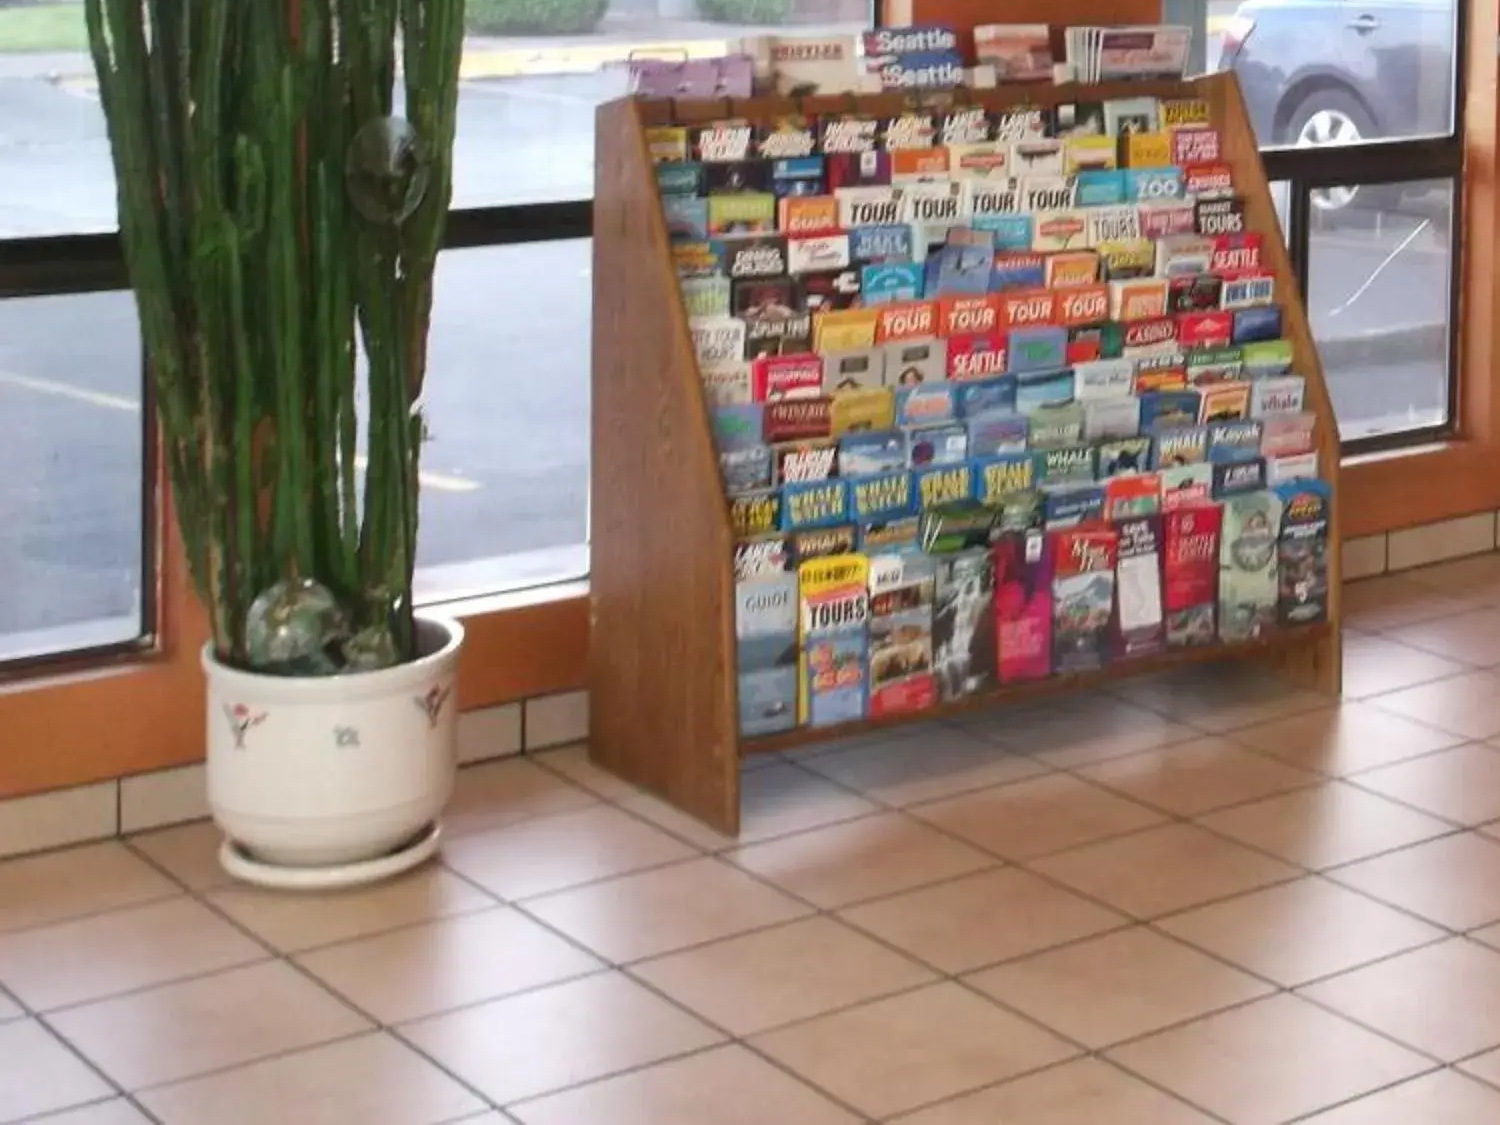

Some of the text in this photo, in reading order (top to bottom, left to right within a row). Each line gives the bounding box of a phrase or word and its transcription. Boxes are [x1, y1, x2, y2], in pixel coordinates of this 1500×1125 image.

[878, 27, 956, 52] Seattle
[889, 64, 963, 87] Seattle
[1138, 174, 1178, 198] ZOO
[911, 196, 958, 219] TOUR
[971, 192, 1016, 214] TOUR
[1027, 188, 1072, 210] TOUR
[850, 201, 898, 224] TOUR
[1200, 213, 1243, 234] TOURS
[1213, 248, 1259, 268] SEATTLE
[1007, 298, 1052, 323] TOUR
[1063, 294, 1107, 318] TOUR
[883, 312, 931, 338] TOUR
[948, 308, 995, 331] TOUR
[953, 350, 1005, 378] SEATTLE
[1160, 428, 1206, 452] WHALE
[1047, 448, 1093, 467] WHALE
[808, 596, 866, 628] TOURS
